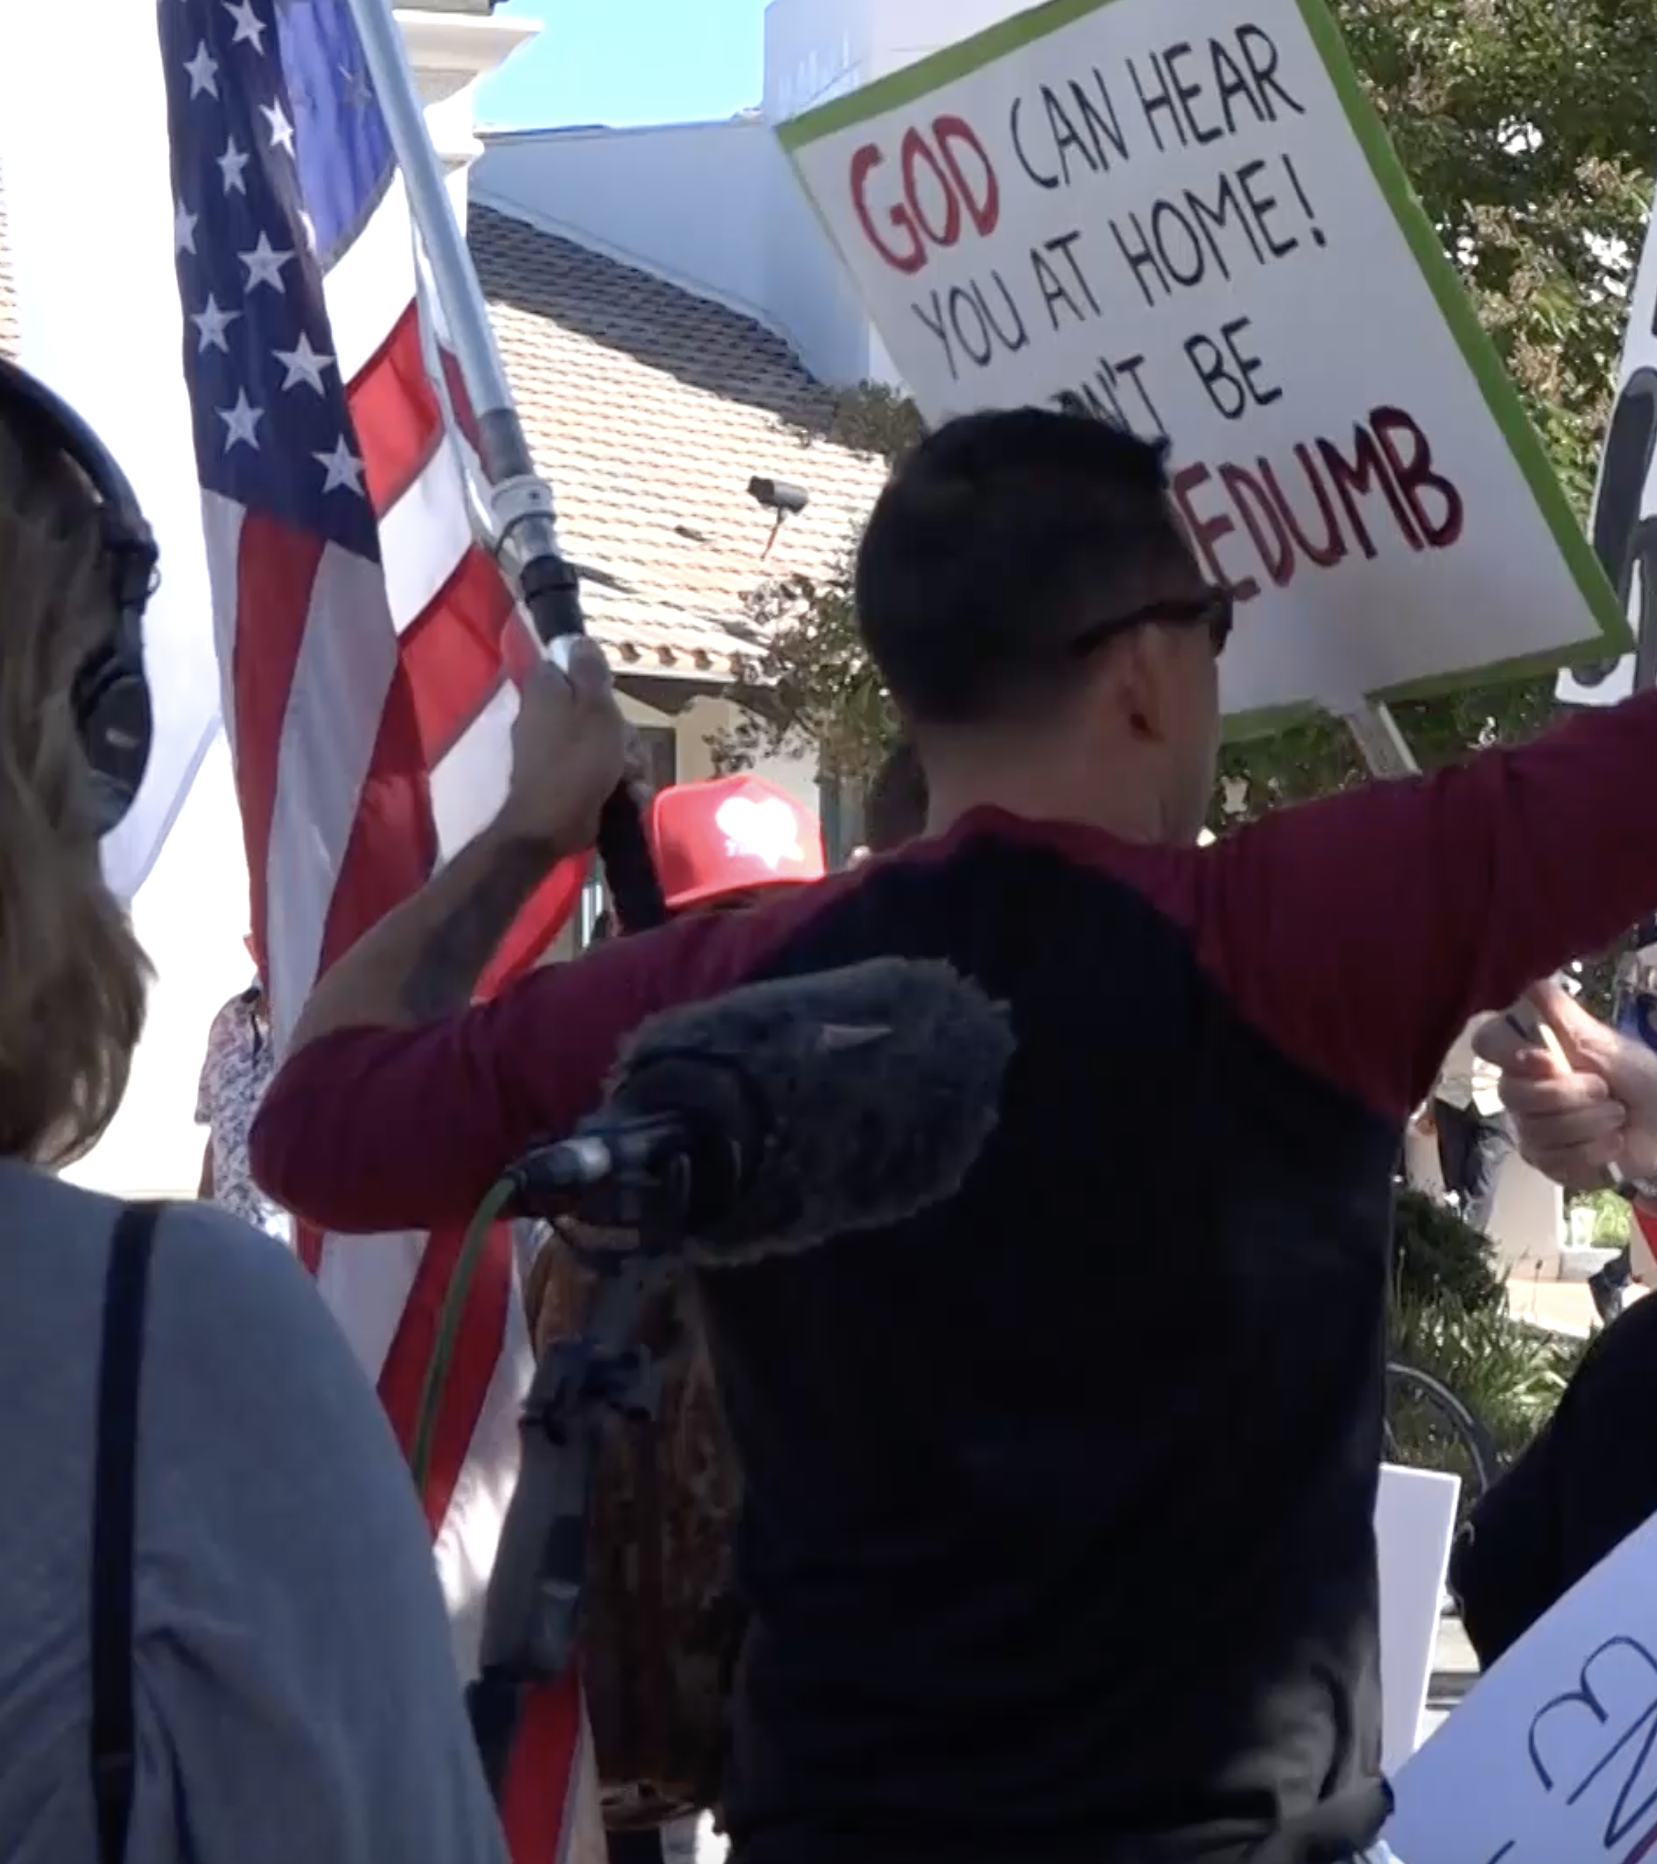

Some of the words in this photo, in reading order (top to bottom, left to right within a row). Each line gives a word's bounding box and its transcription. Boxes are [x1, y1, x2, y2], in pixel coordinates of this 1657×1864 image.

[849, 114, 1000, 275] GOD
[1009, 67, 1130, 191] CAN
[1125, 22, 1307, 153] HEAR
[912, 272, 1031, 382] YOU
[1028, 231, 1103, 333] AT
[1108, 153, 1328, 310] HOME!
[1183, 316, 1284, 421] BE
[1172, 404, 1465, 604] EDUMB
